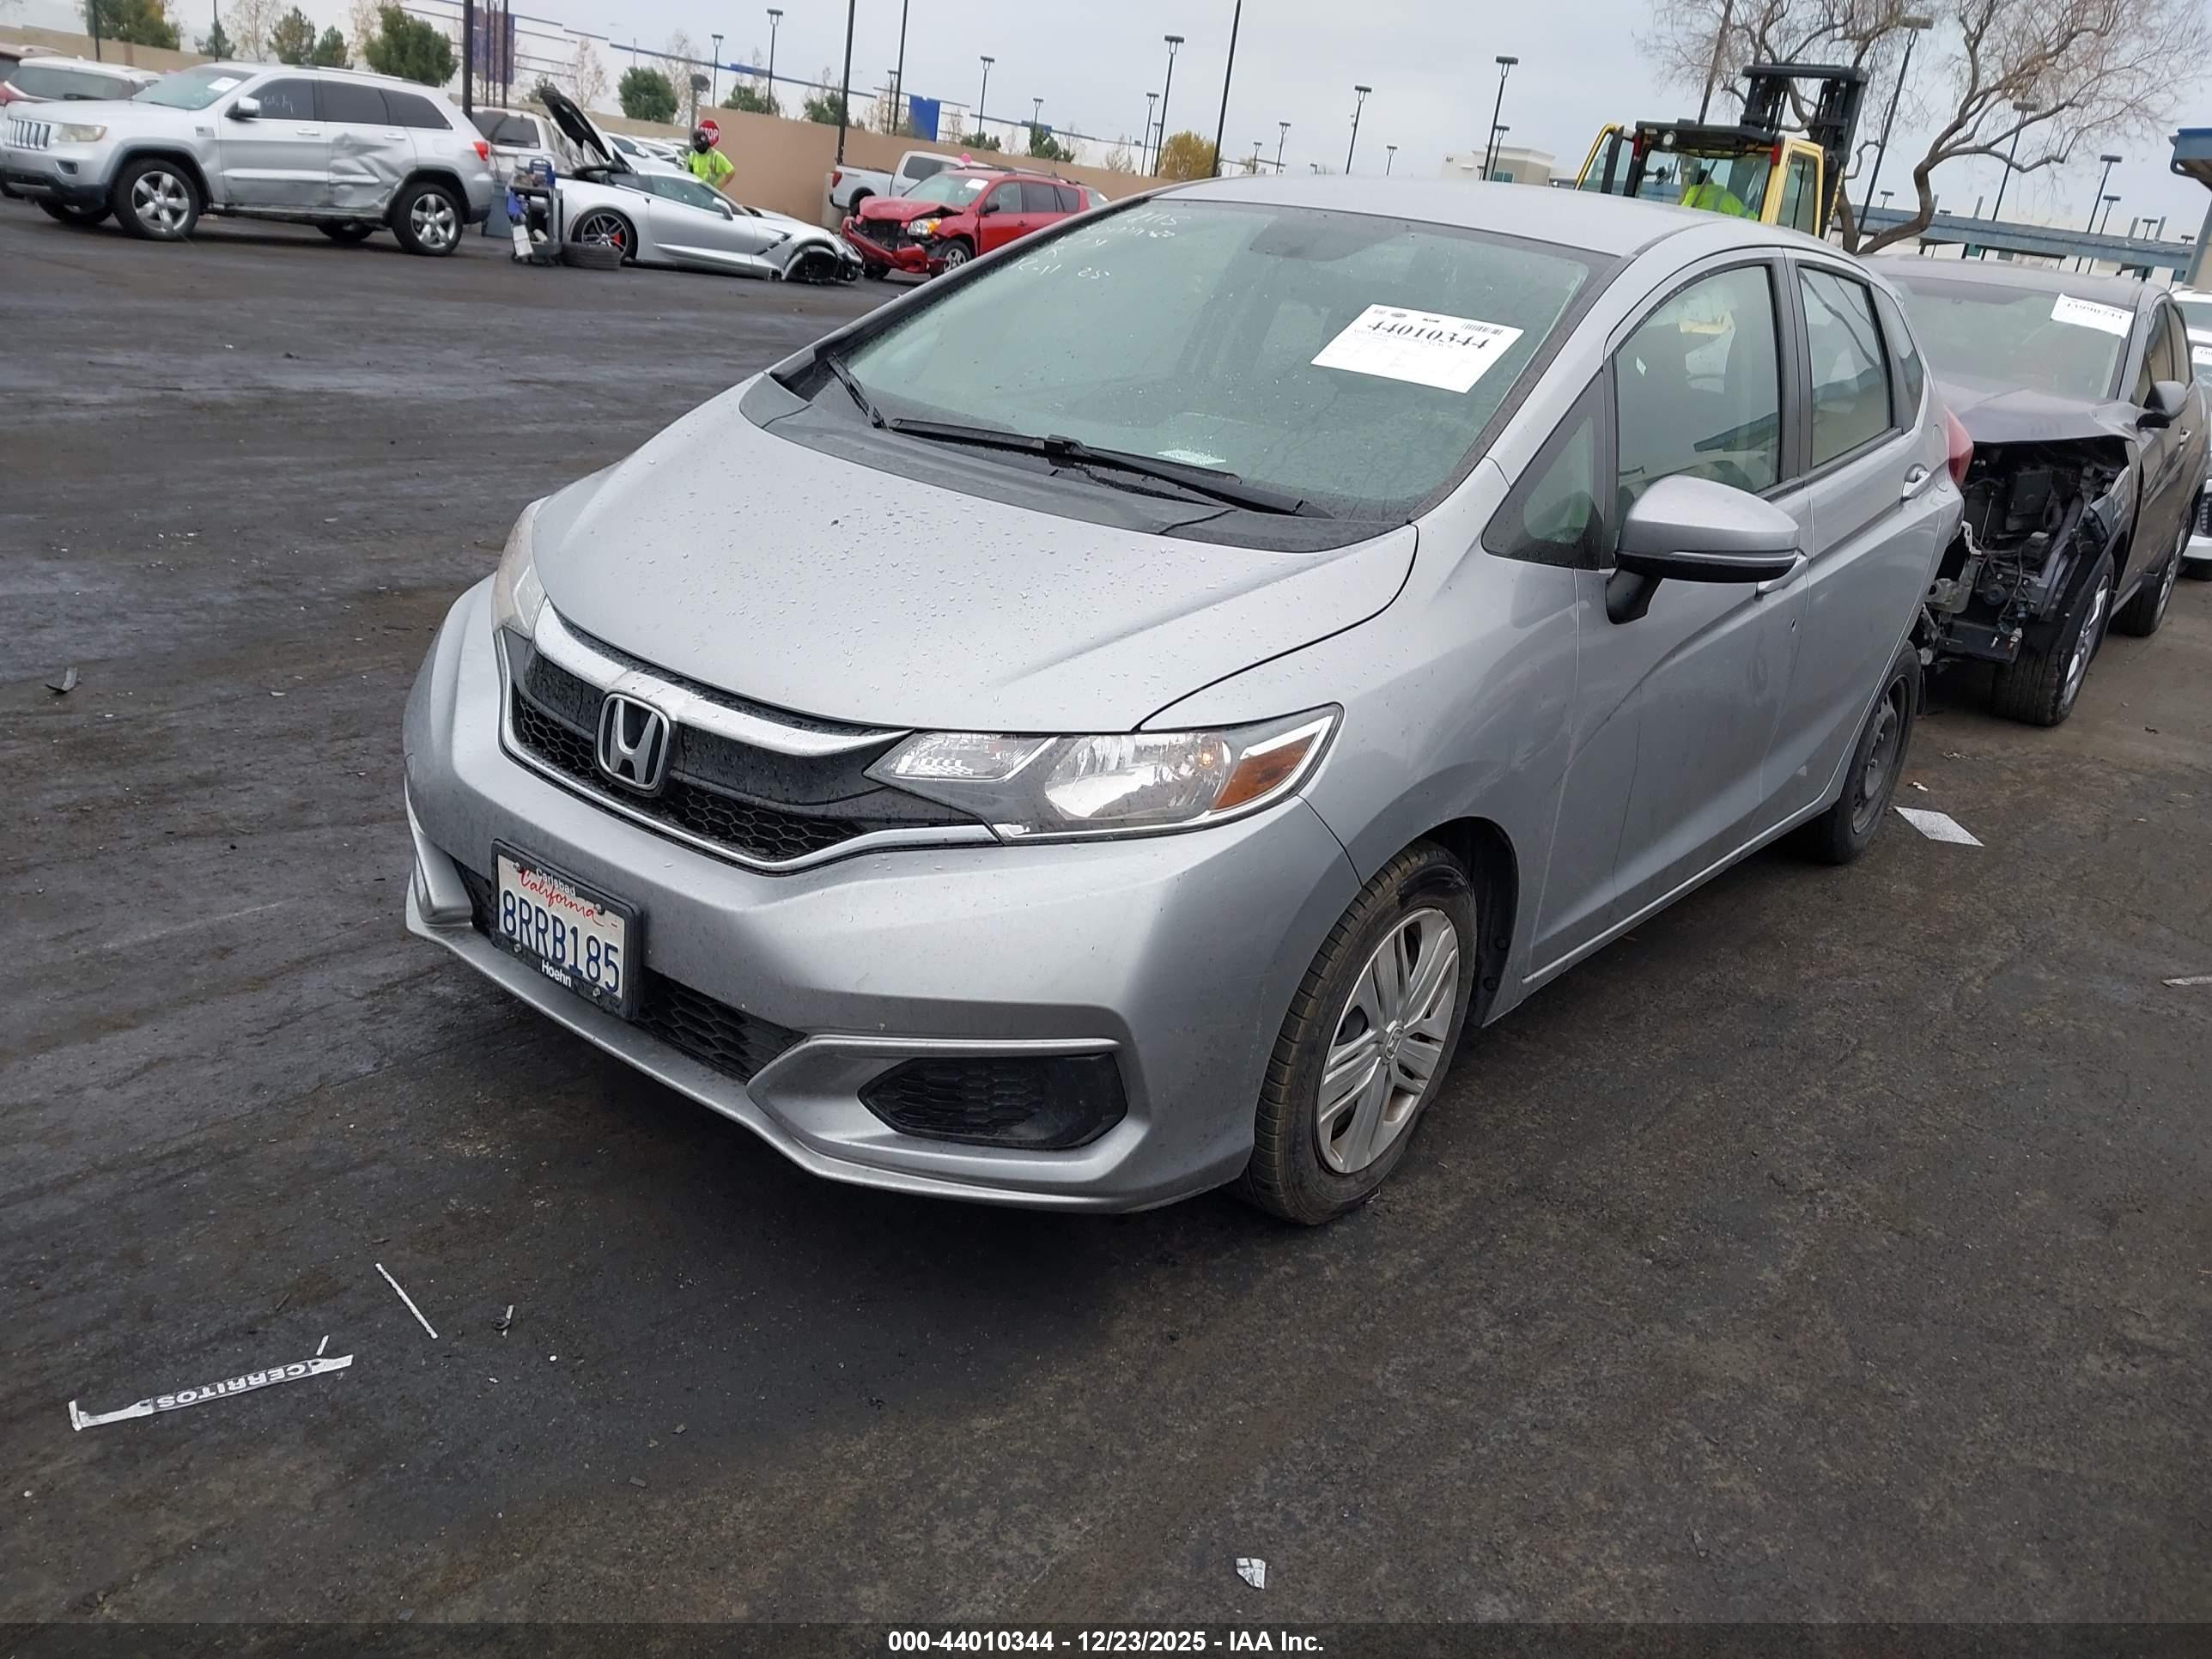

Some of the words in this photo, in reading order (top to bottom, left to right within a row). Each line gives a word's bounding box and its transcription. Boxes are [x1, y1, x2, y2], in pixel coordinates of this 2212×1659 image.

[1367, 320, 1490, 349] 44010344
[520, 868, 605, 927] California
[536, 867, 576, 897] Carlsbad
[502, 890, 620, 994] 8RRB185
[541, 960, 572, 987] Hoehn
[156, 1364, 307, 1407] CERRITOS
